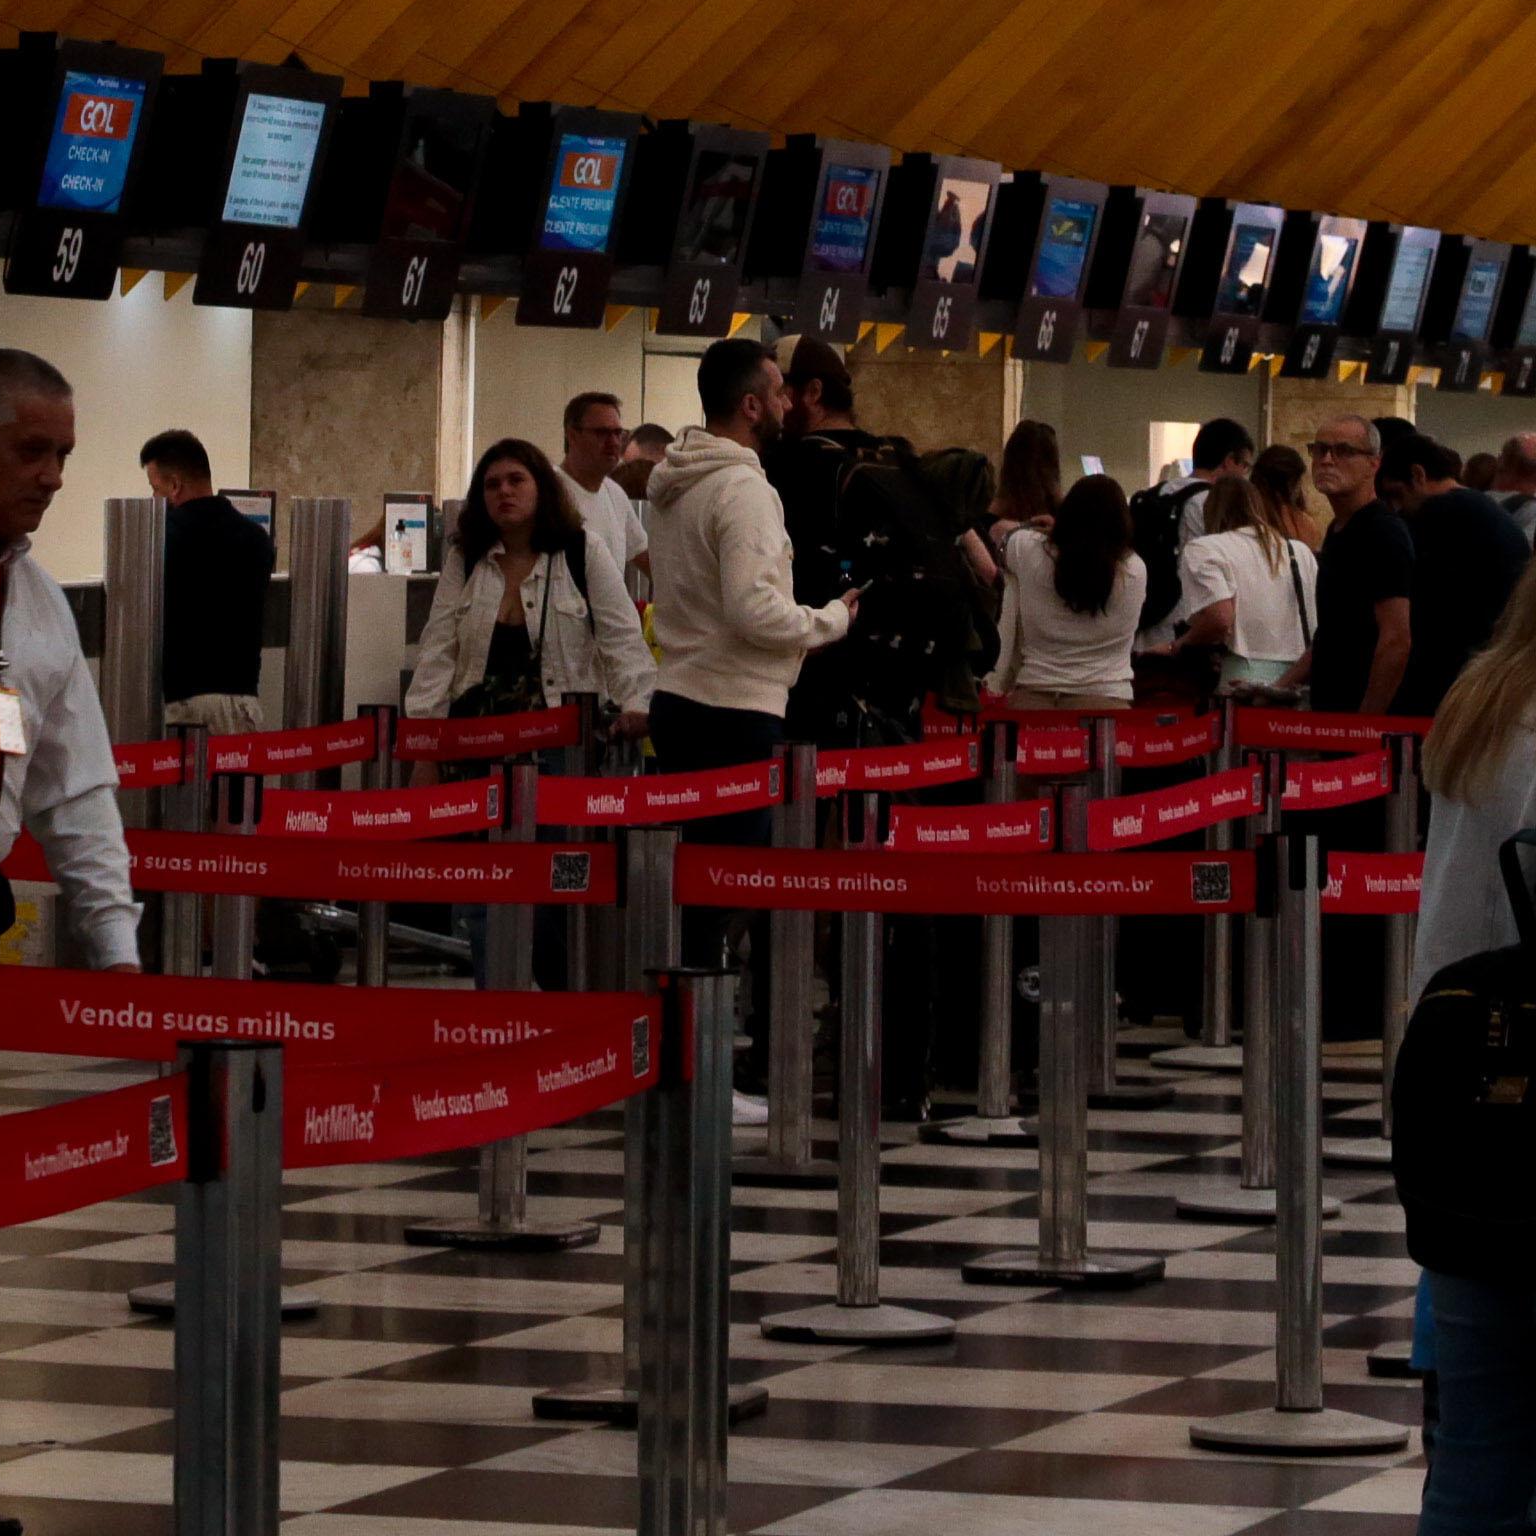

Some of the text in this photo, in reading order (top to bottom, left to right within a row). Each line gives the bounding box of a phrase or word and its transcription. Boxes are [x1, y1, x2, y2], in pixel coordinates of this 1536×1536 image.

[80, 99, 114, 134] GOL
[68, 145, 111, 164] CHECK-IN
[573, 156, 602, 186] GOL
[60, 174, 105, 193] CHECK-IN
[52, 227, 83, 283] 59
[237, 241, 266, 295] 60
[402, 256, 429, 306] 61
[553, 266, 579, 314] 62
[688, 277, 711, 324] 63
[819, 286, 841, 331] 64
[931, 295, 952, 339] 65
[144, 855, 193, 871] suas
[198, 853, 268, 875] milhas
[337, 860, 514, 882] hotmilhas.com.br
[708, 867, 1155, 894] Venda suas milhas hotmilhas.com.br
[59, 999, 153, 1030] Venda
[162, 1011, 230, 1035] suas
[237, 1012, 336, 1041] milhas
[303, 1050, 618, 1146] HotMilhas Venda suas milhas hotmilhas.com.br
[24, 1130, 130, 1181] hotmilhas.com.br
